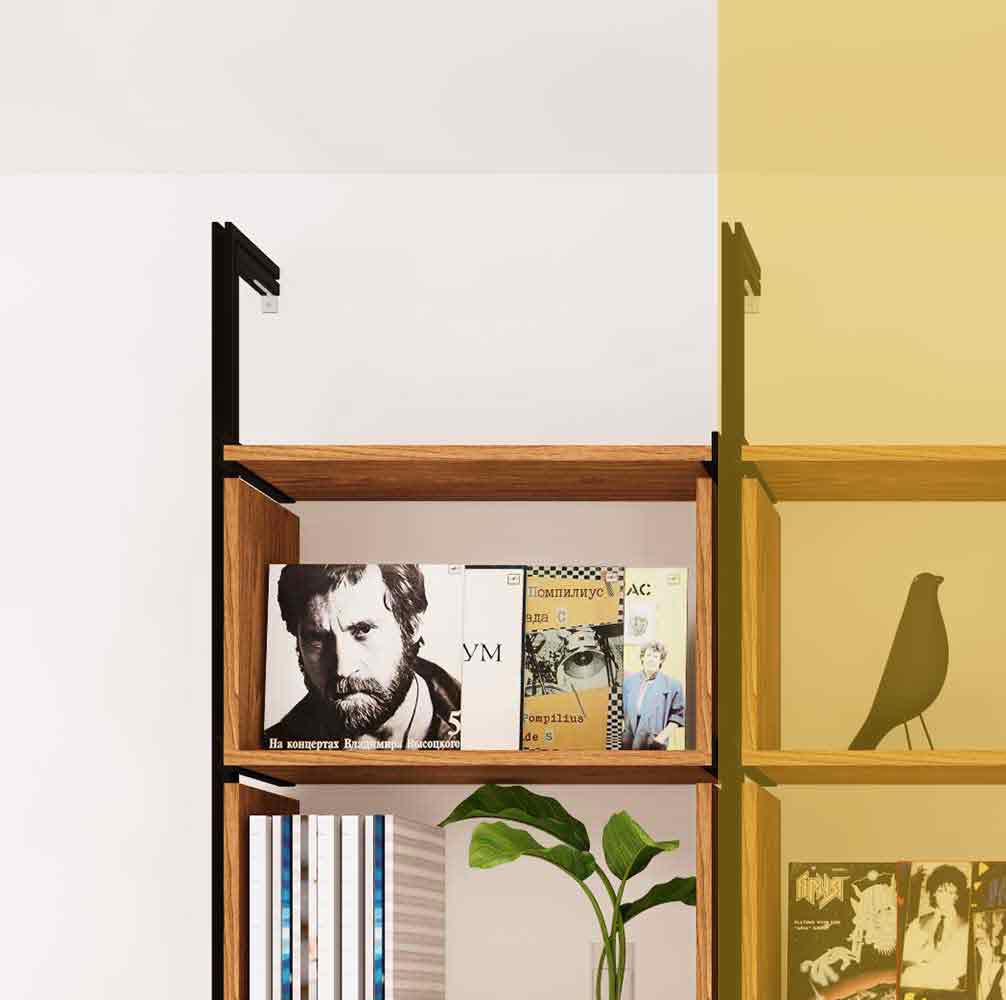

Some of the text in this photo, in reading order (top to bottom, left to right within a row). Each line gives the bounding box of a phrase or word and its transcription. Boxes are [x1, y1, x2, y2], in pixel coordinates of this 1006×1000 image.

[527, 586, 604, 600] Помпилиус
[447, 711, 461, 736] 5
[269, 738, 283, 749] На
[287, 740, 340, 751] концертах
